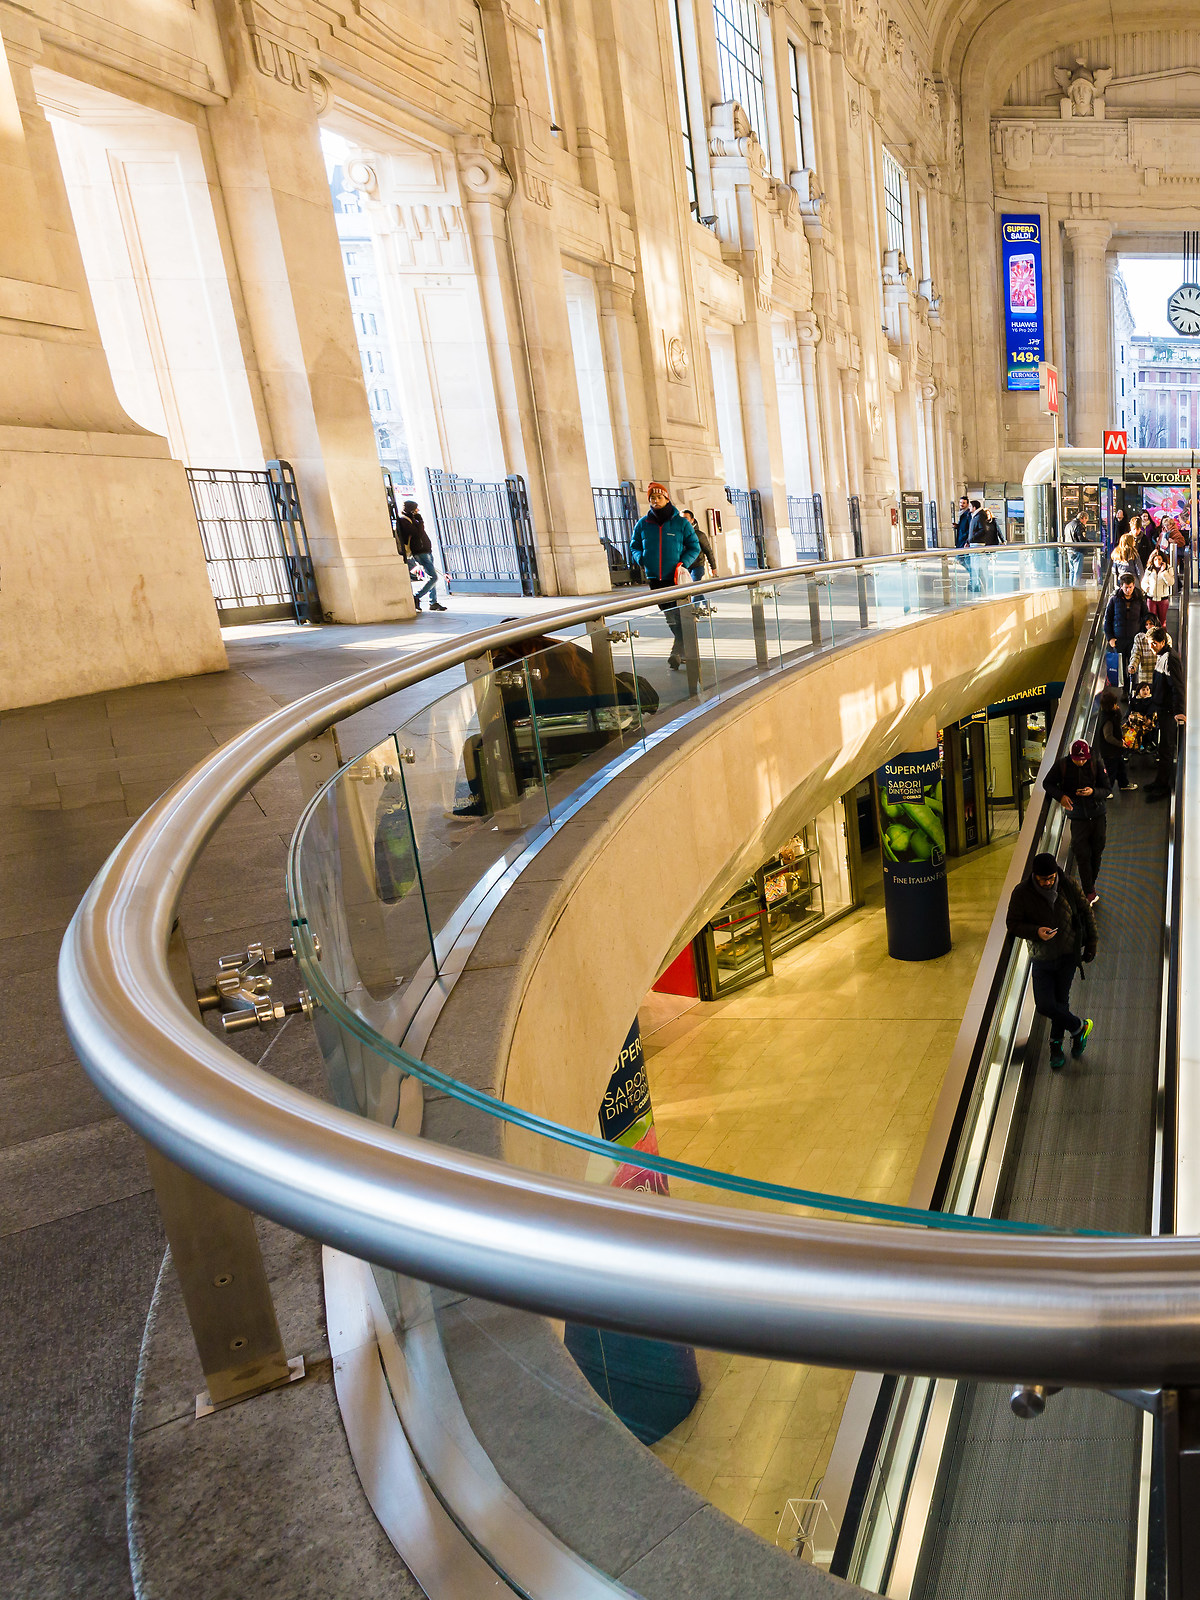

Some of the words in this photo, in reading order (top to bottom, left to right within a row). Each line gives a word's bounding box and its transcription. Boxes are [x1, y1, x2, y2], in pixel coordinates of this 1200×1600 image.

[1006, 225, 1035, 233] SUPERA
[1010, 232, 1031, 240] SALDI
[1011, 351, 1040, 363] 149€
[1106, 434, 1126, 450] M
[888, 780, 921, 789] SAPORI
